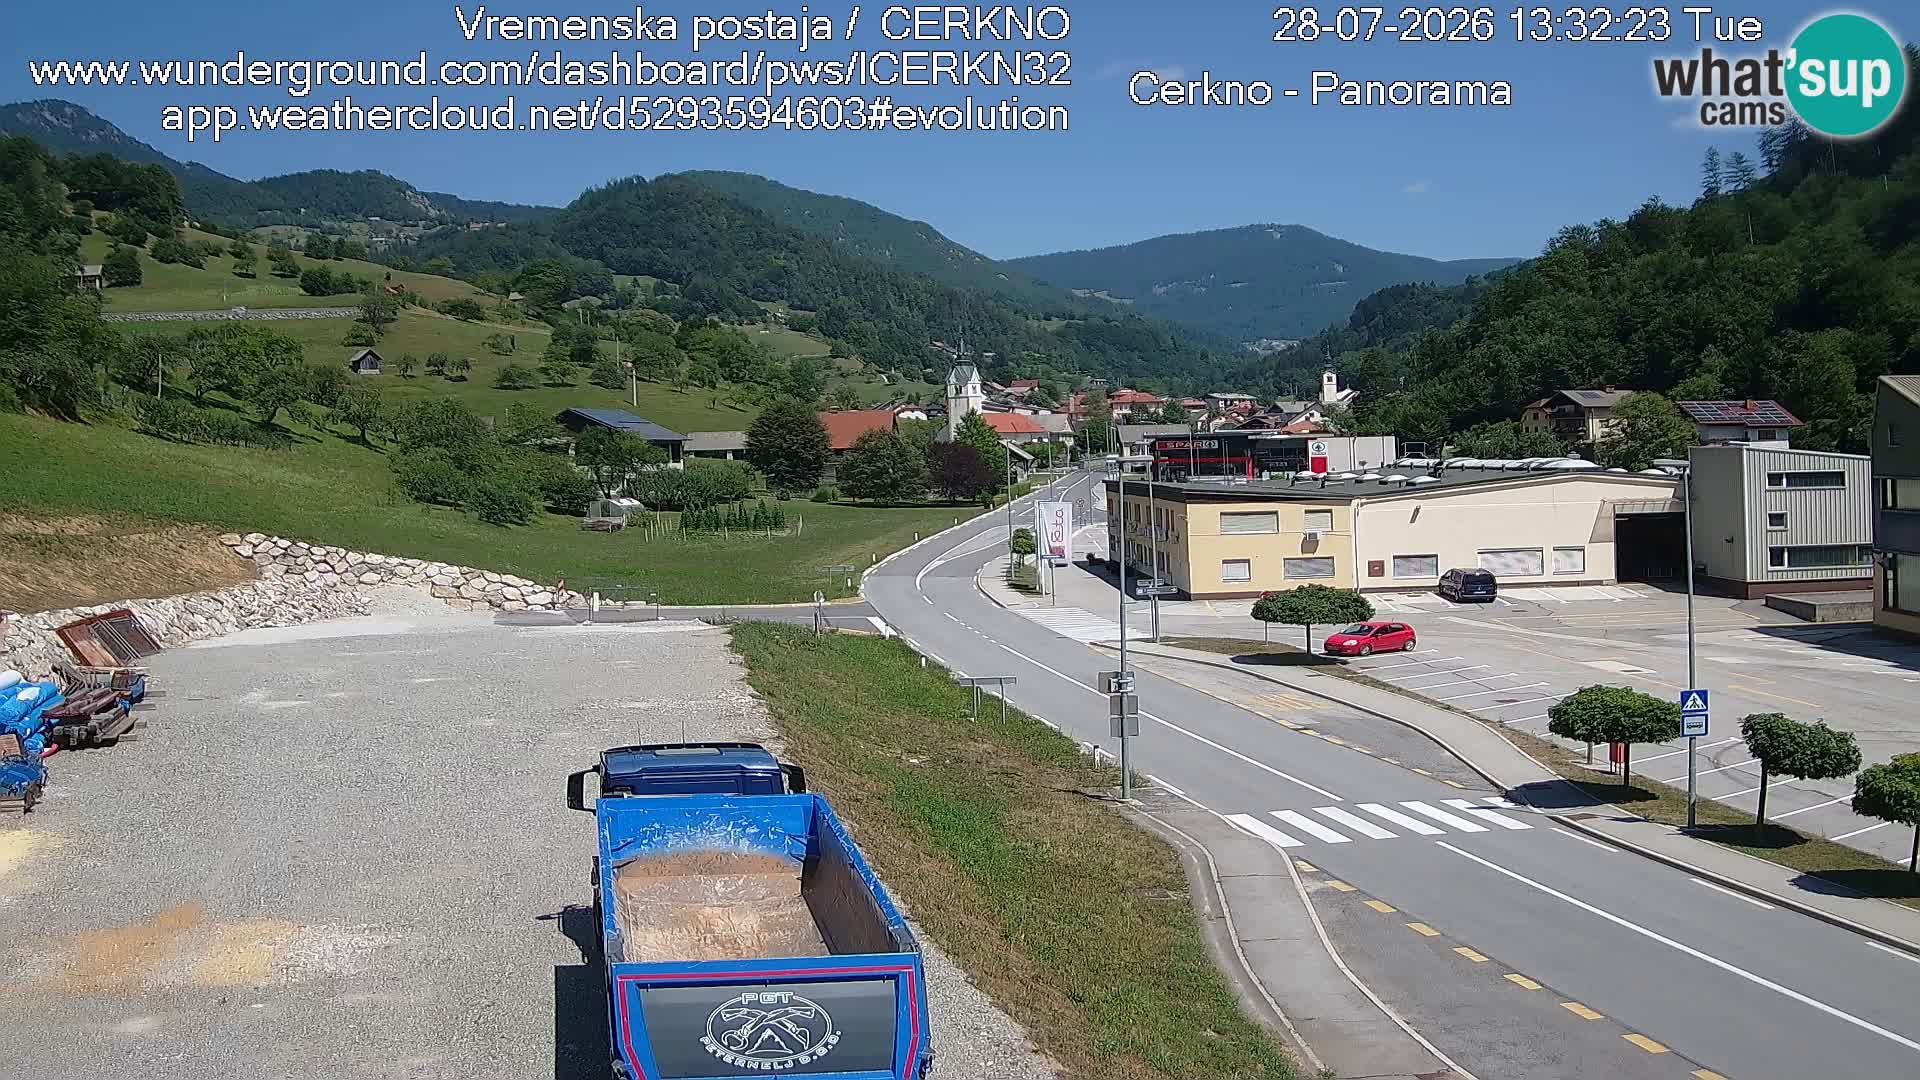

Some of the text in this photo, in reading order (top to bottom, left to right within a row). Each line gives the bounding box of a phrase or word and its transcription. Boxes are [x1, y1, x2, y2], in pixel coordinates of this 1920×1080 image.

[1166, 441, 1203, 449] SPAR
[741, 991, 794, 1005] PGT
[700, 1036, 794, 1070] PETERNELJ
